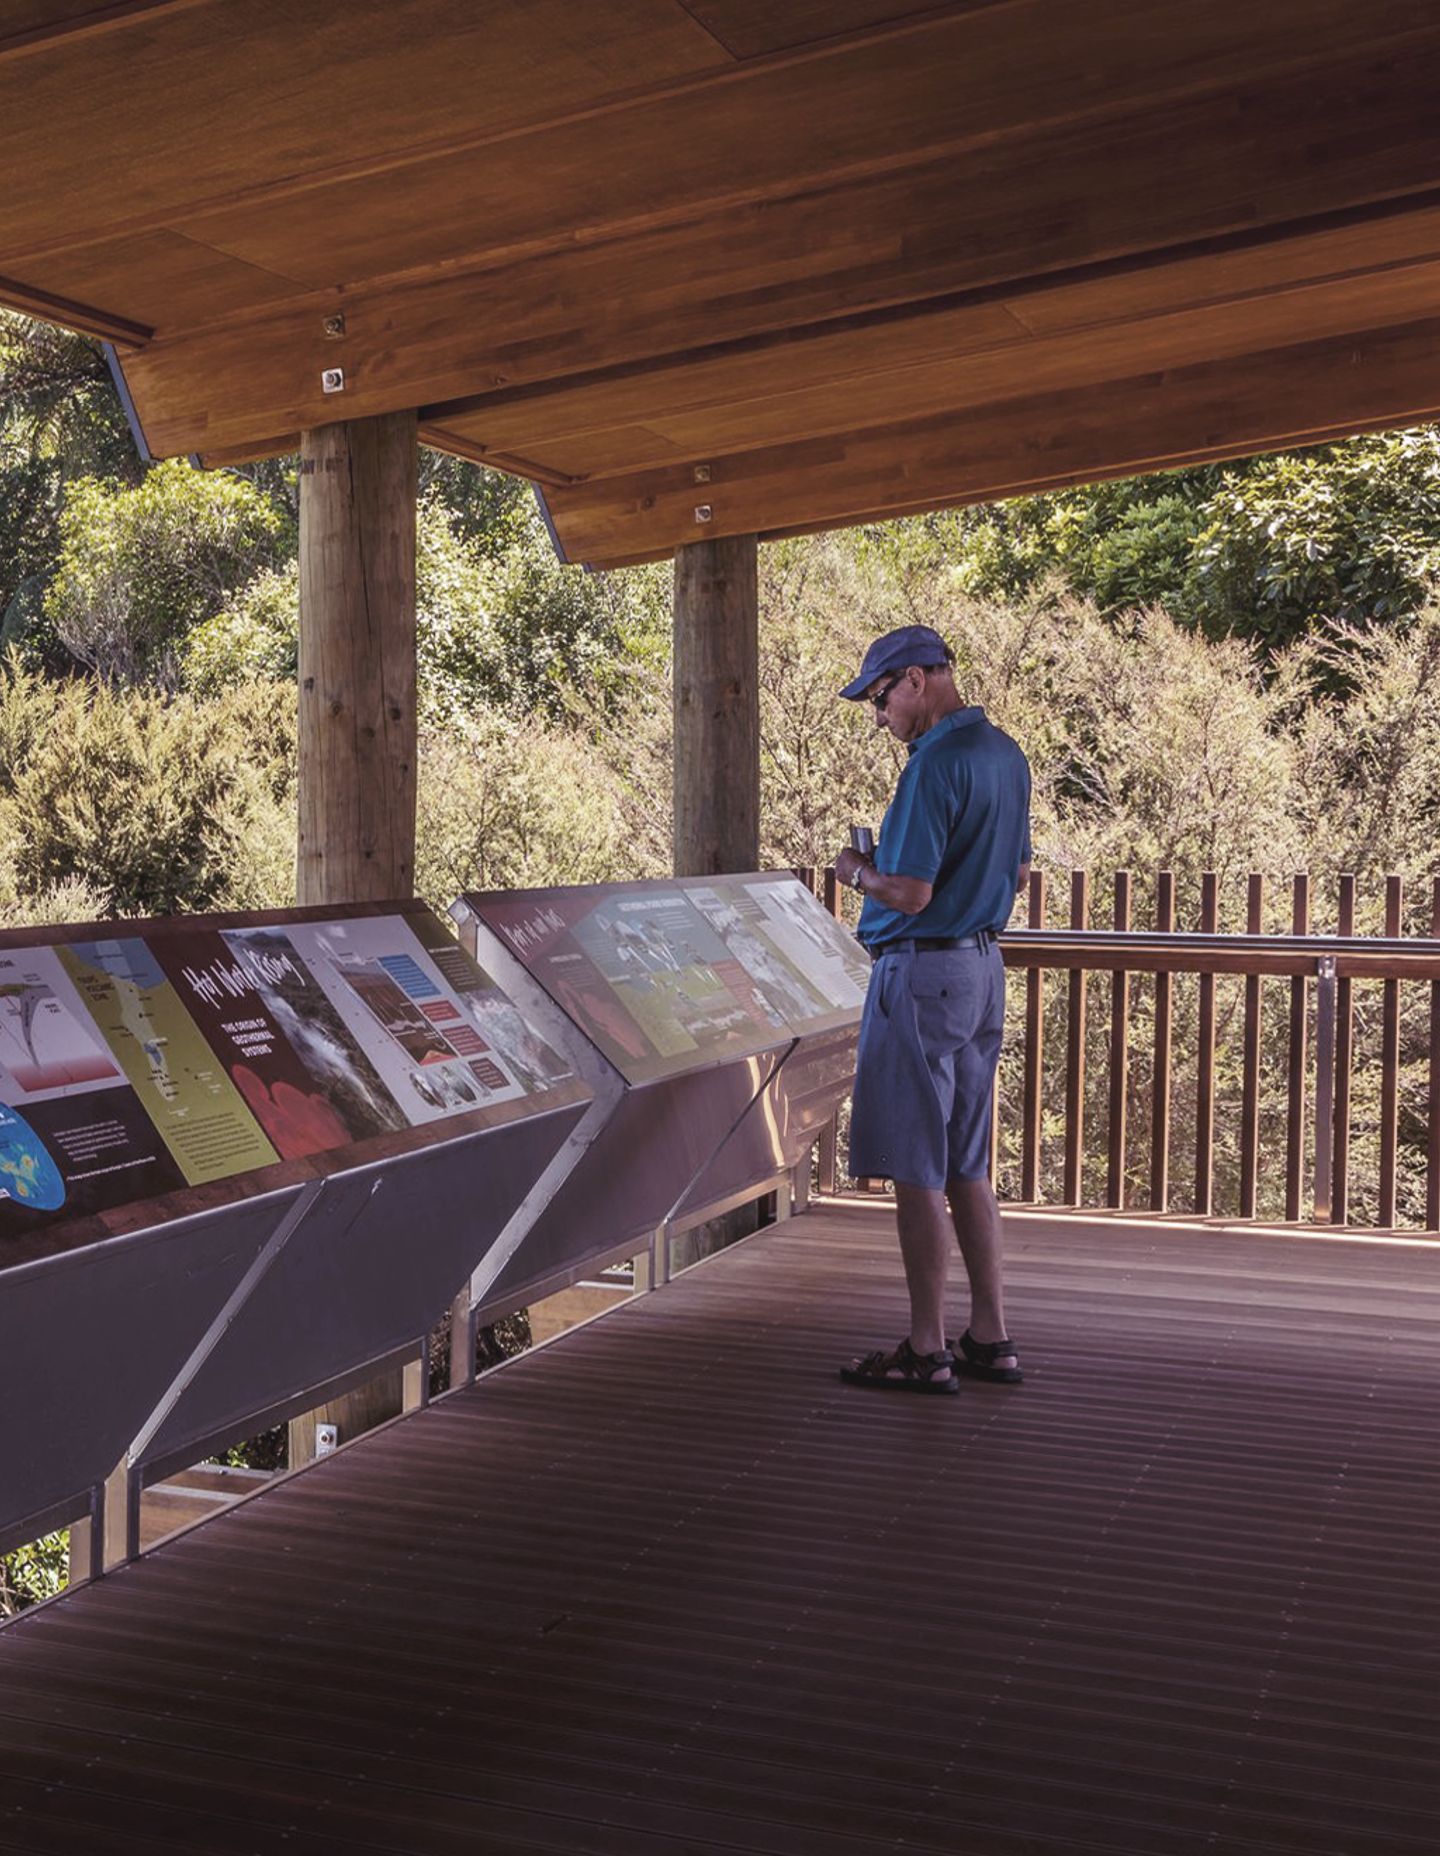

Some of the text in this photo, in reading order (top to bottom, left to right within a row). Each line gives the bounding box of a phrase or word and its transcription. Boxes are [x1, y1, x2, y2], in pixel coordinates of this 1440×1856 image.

[181, 948, 306, 1010] Hot Water Rising
